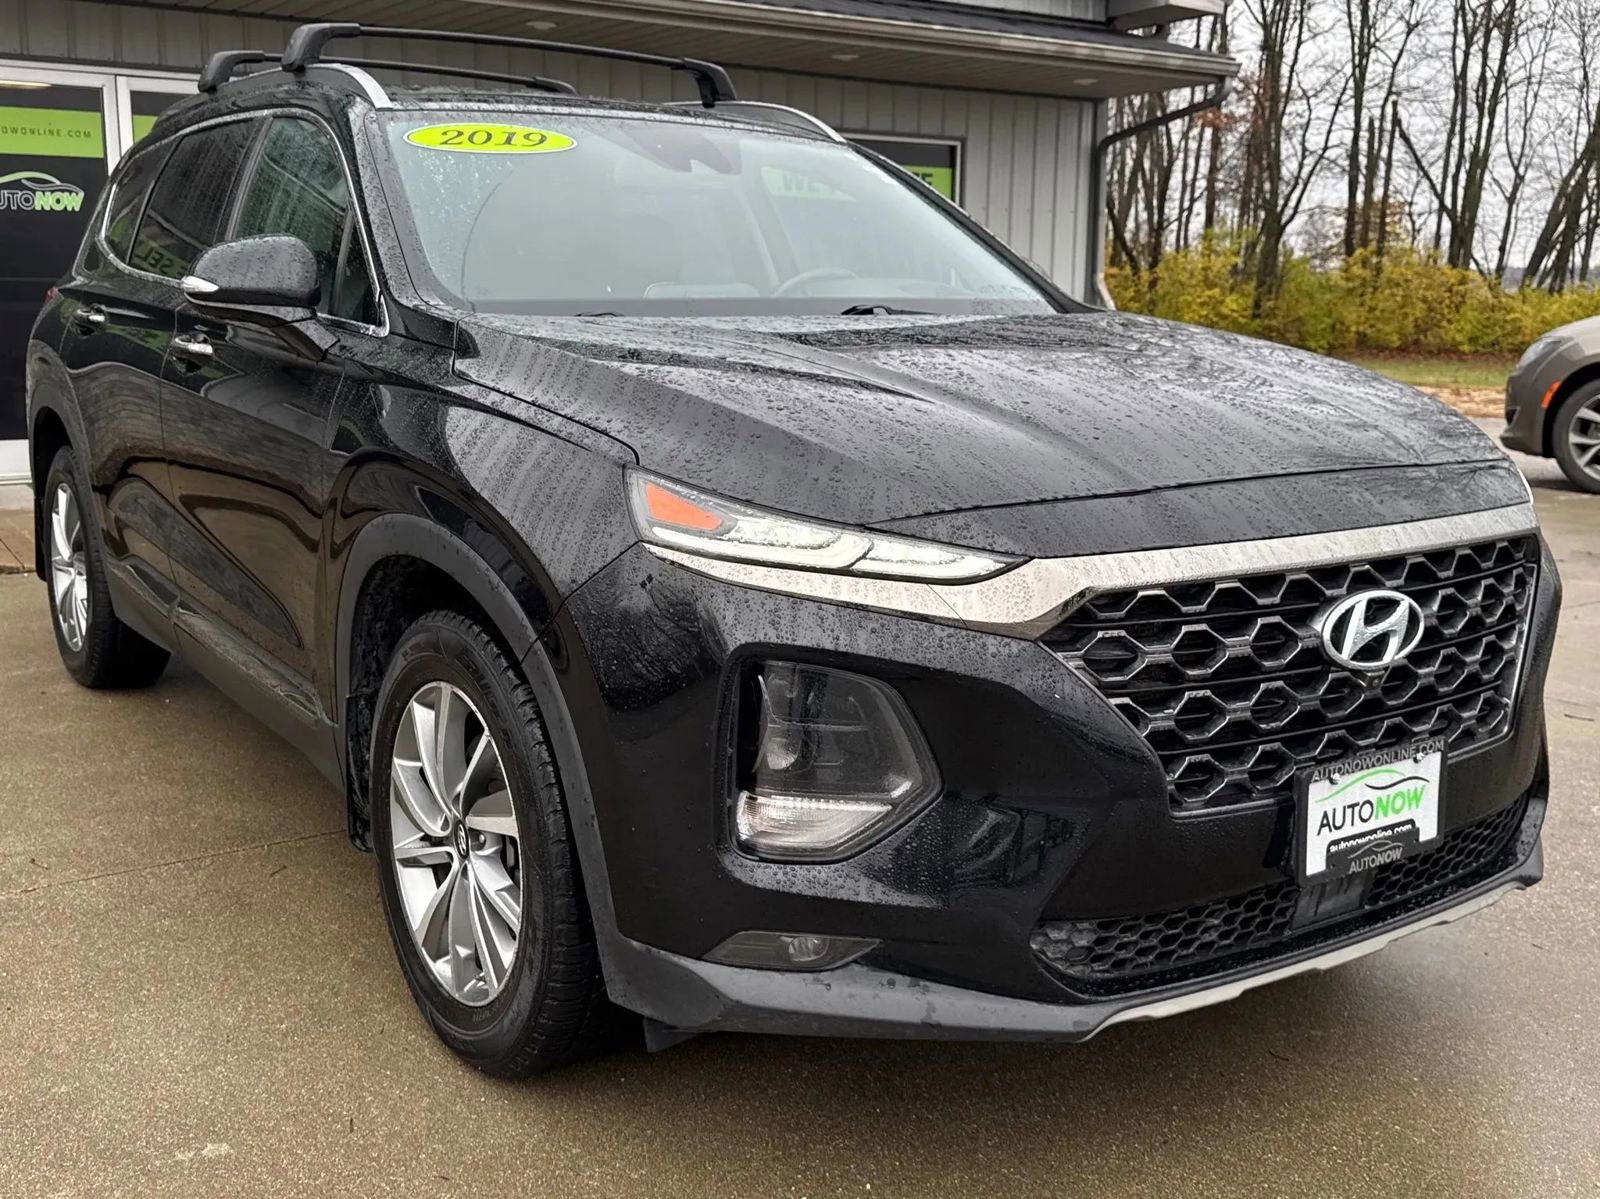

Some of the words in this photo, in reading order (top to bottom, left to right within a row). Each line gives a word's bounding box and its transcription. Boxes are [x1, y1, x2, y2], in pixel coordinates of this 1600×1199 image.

[439, 129, 548, 147] 2019
[1317, 785, 1426, 836] AUTONOW
[1329, 823, 1413, 853] autonowonlinecom
[1348, 847, 1403, 875] AUTONOW
